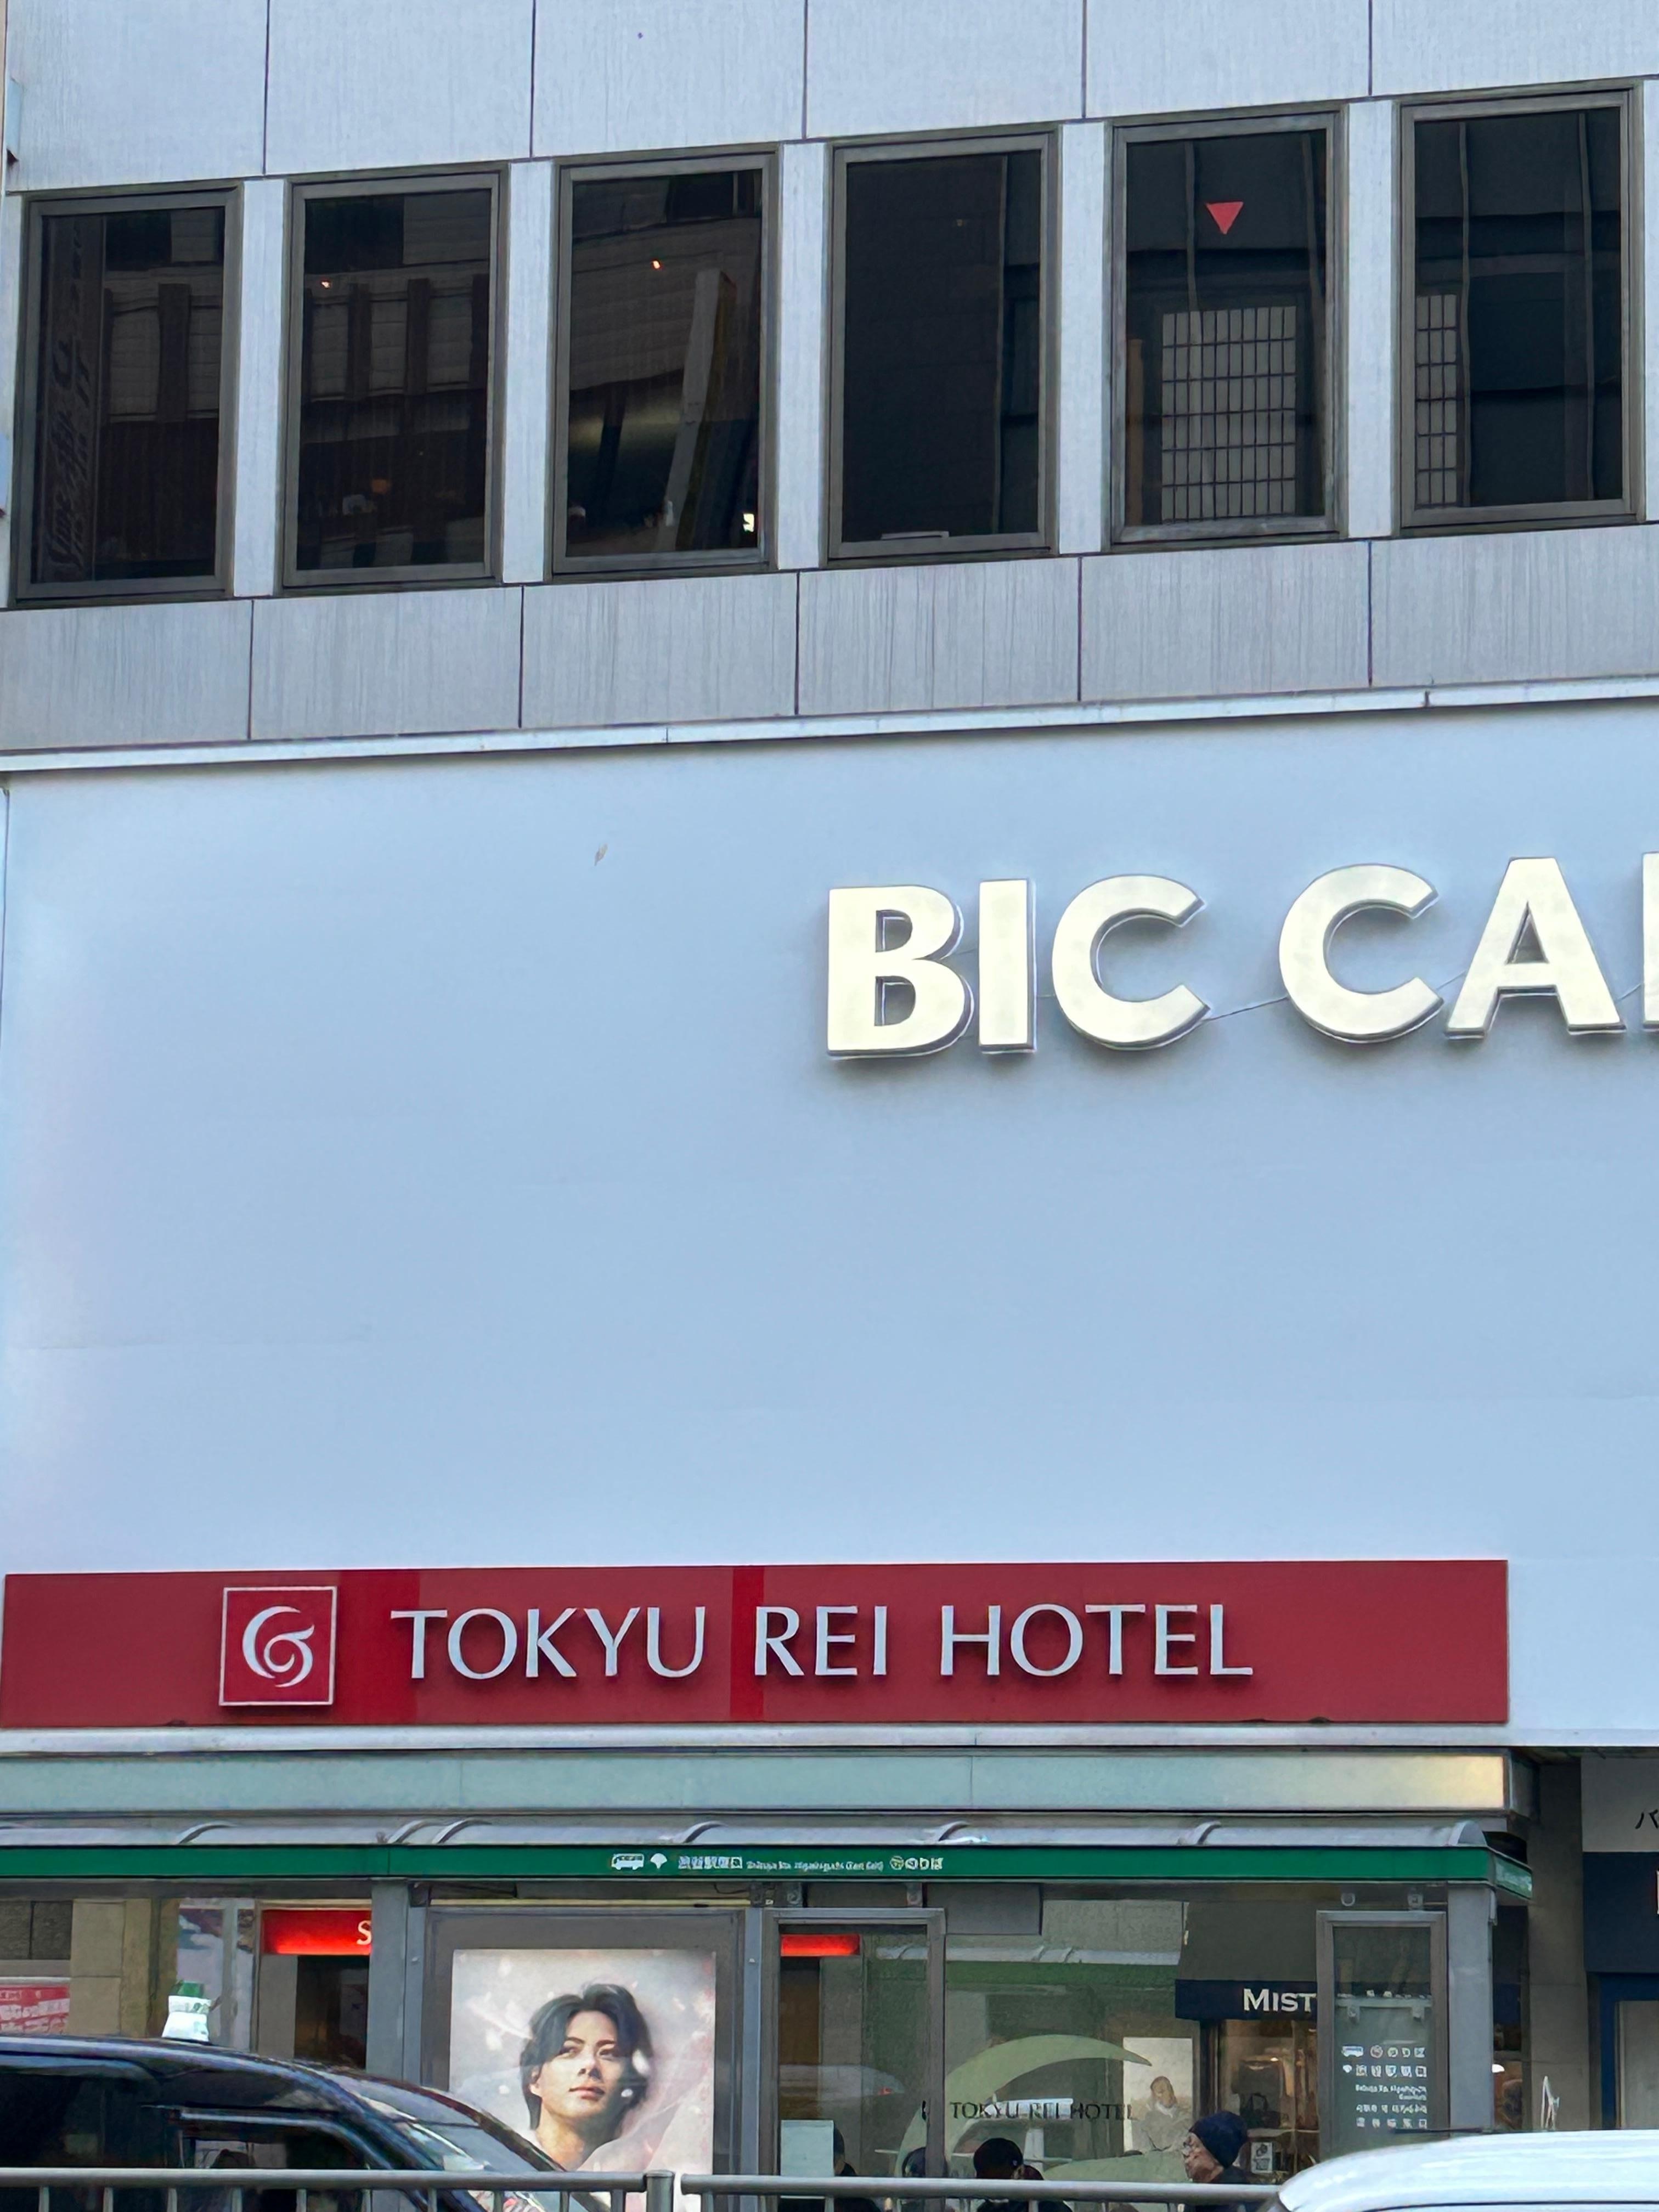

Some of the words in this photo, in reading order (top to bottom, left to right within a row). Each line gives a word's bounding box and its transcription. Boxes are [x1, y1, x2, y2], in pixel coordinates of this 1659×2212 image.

[827, 874, 1210, 1059] BIC
[1278, 852, 1659, 1042] CA
[390, 1606, 706, 1680] TOKYU
[754, 1605, 888, 1677] REI
[940, 1603, 1254, 1677] HOTEL
[950, 2101, 1019, 2119] TOKYU
[1070, 2102, 1140, 2121] HOTEL
